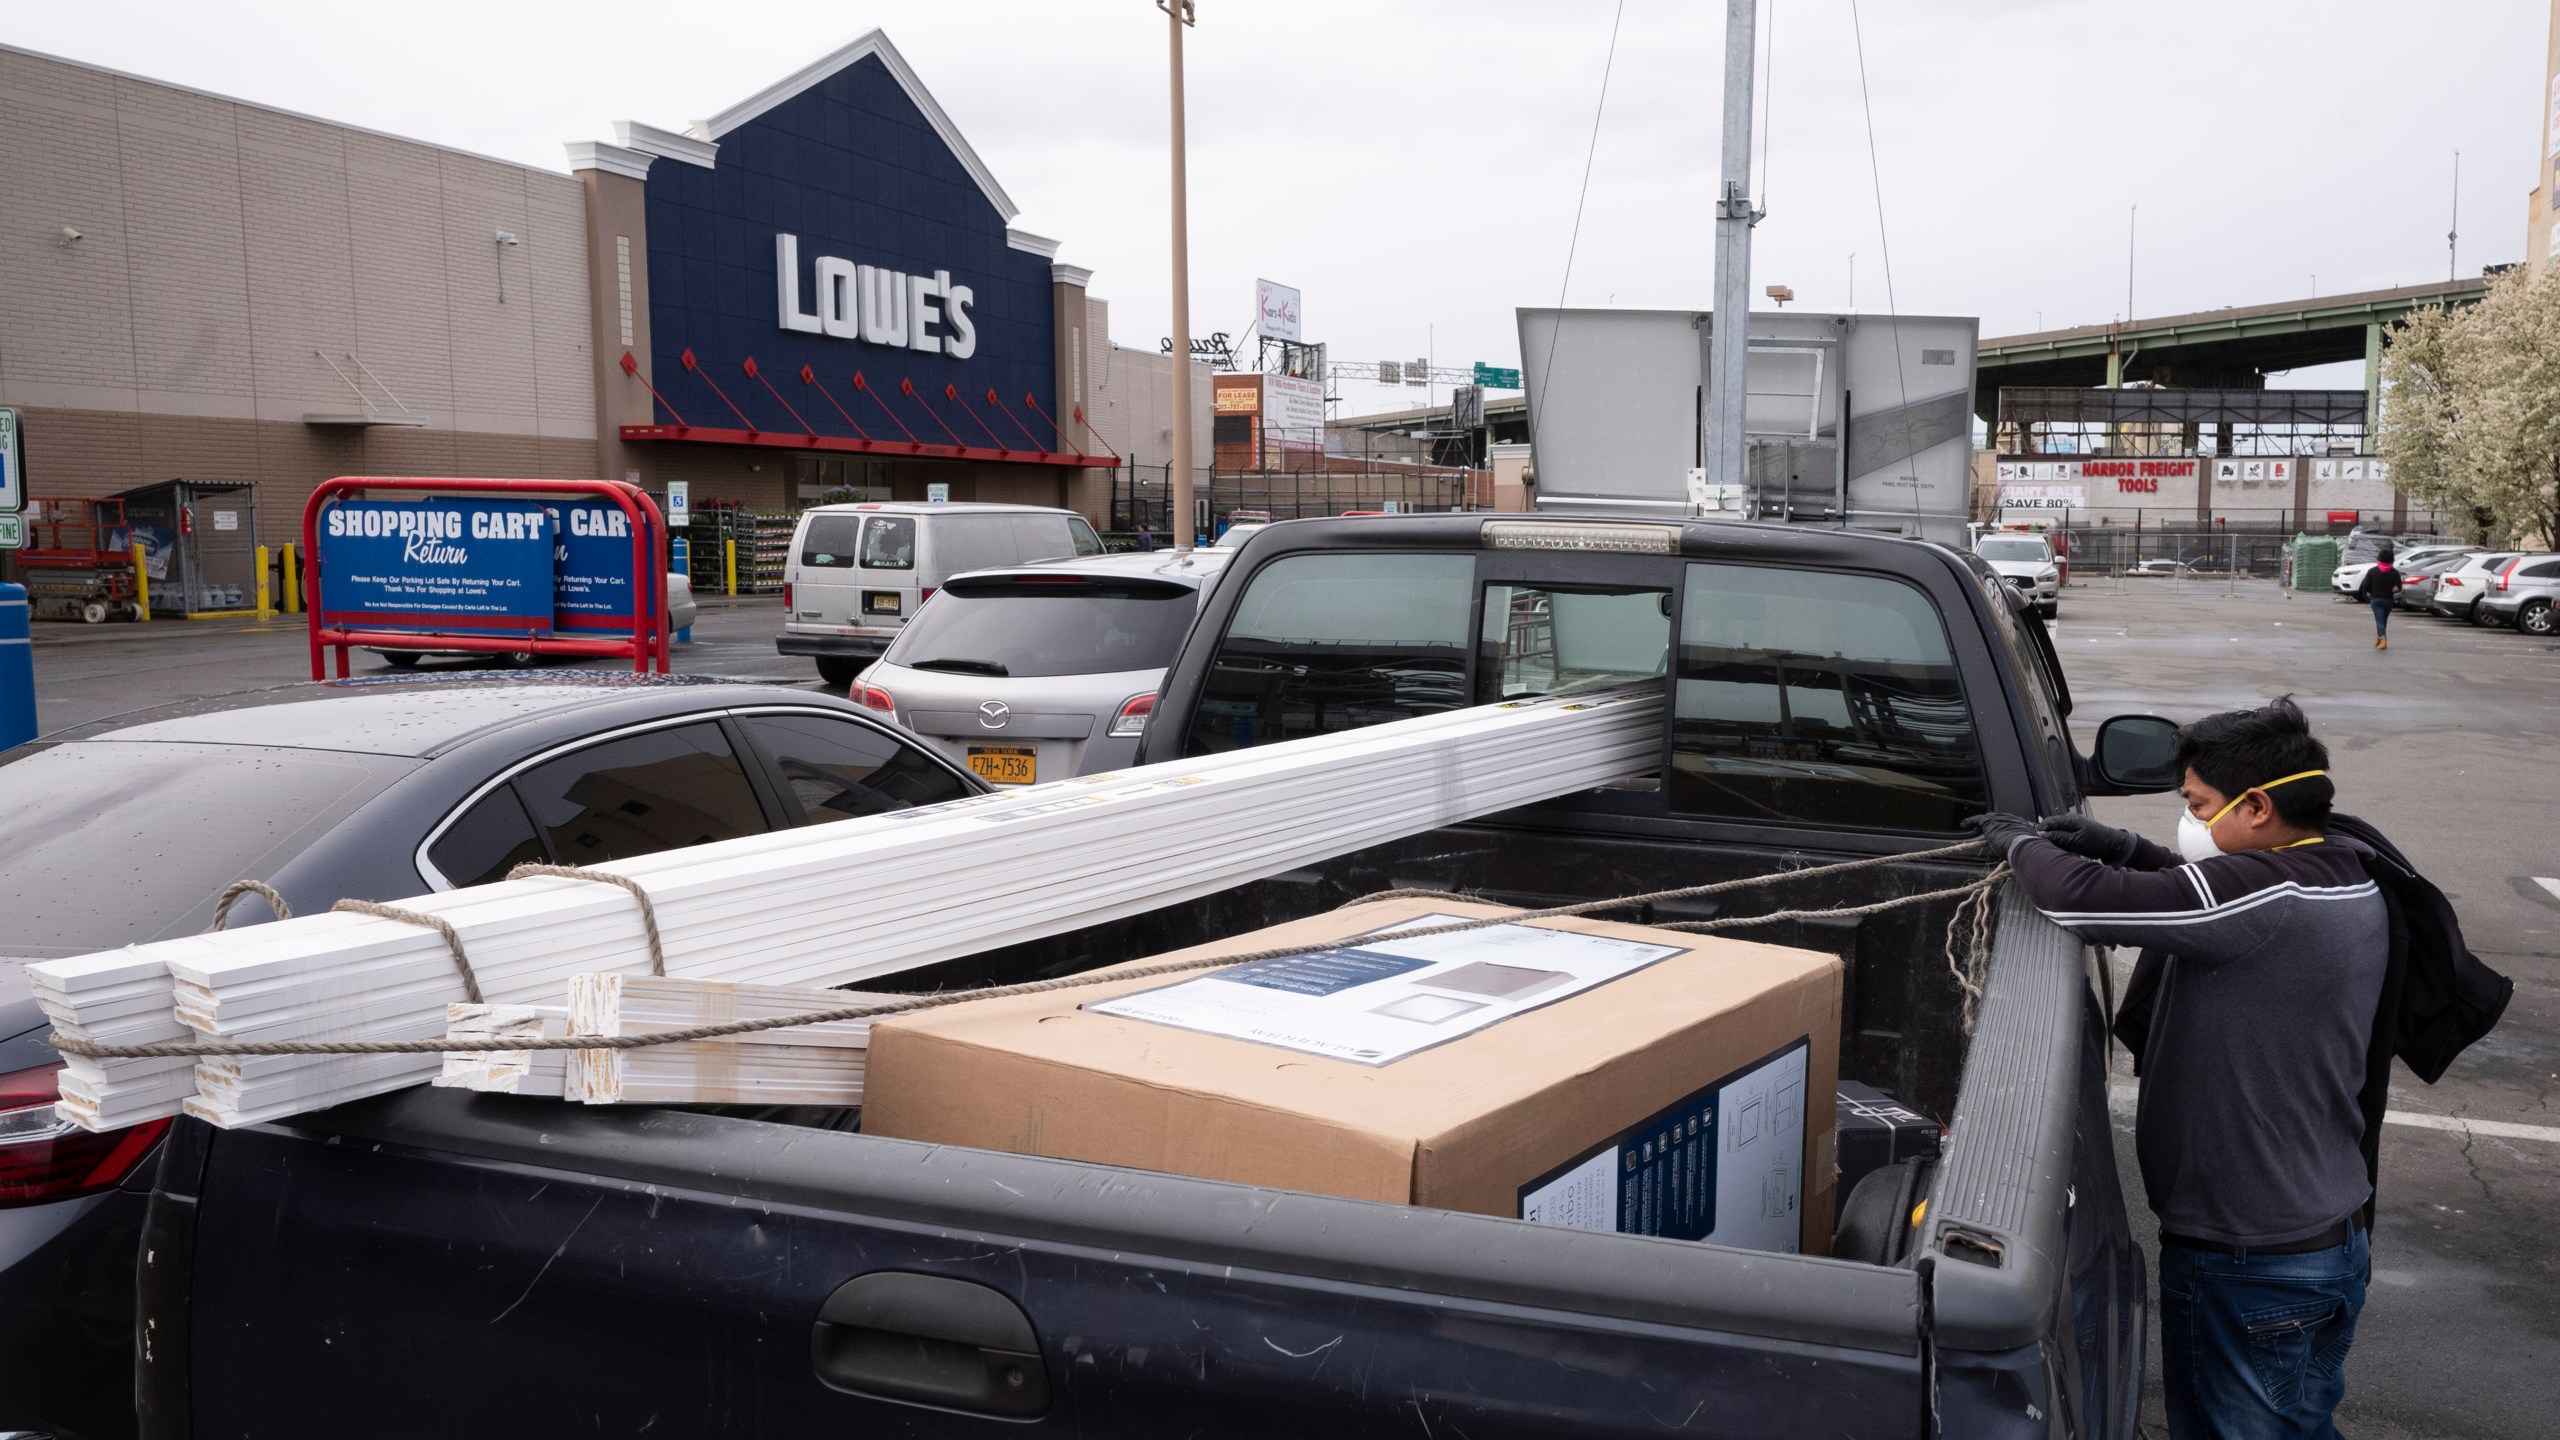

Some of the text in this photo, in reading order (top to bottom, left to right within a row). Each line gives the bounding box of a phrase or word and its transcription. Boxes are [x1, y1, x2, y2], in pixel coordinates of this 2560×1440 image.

[776, 233, 977, 359] LOWE'S
[1282, 300, 1297, 327] Kids
[2082, 462, 2196, 477] HARBOR FREIGHT
[2046, 486, 2082, 497] SALE
[2118, 478, 2158, 493] TOOLS
[2004, 498, 2076, 508] SAVE 80%
[329, 510, 462, 539] SHOPPING
[472, 512, 544, 540] CART
[404, 530, 468, 564] Return
[372, 576, 388, 584] Keep
[402, 576, 424, 585] Parking
[462, 578, 489, 587] Returning
[564, 576, 592, 584] Returning
[610, 577, 626, 585] Cart.
[429, 586, 456, 595] Shopping
[1000, 758, 1028, 776] 7536
